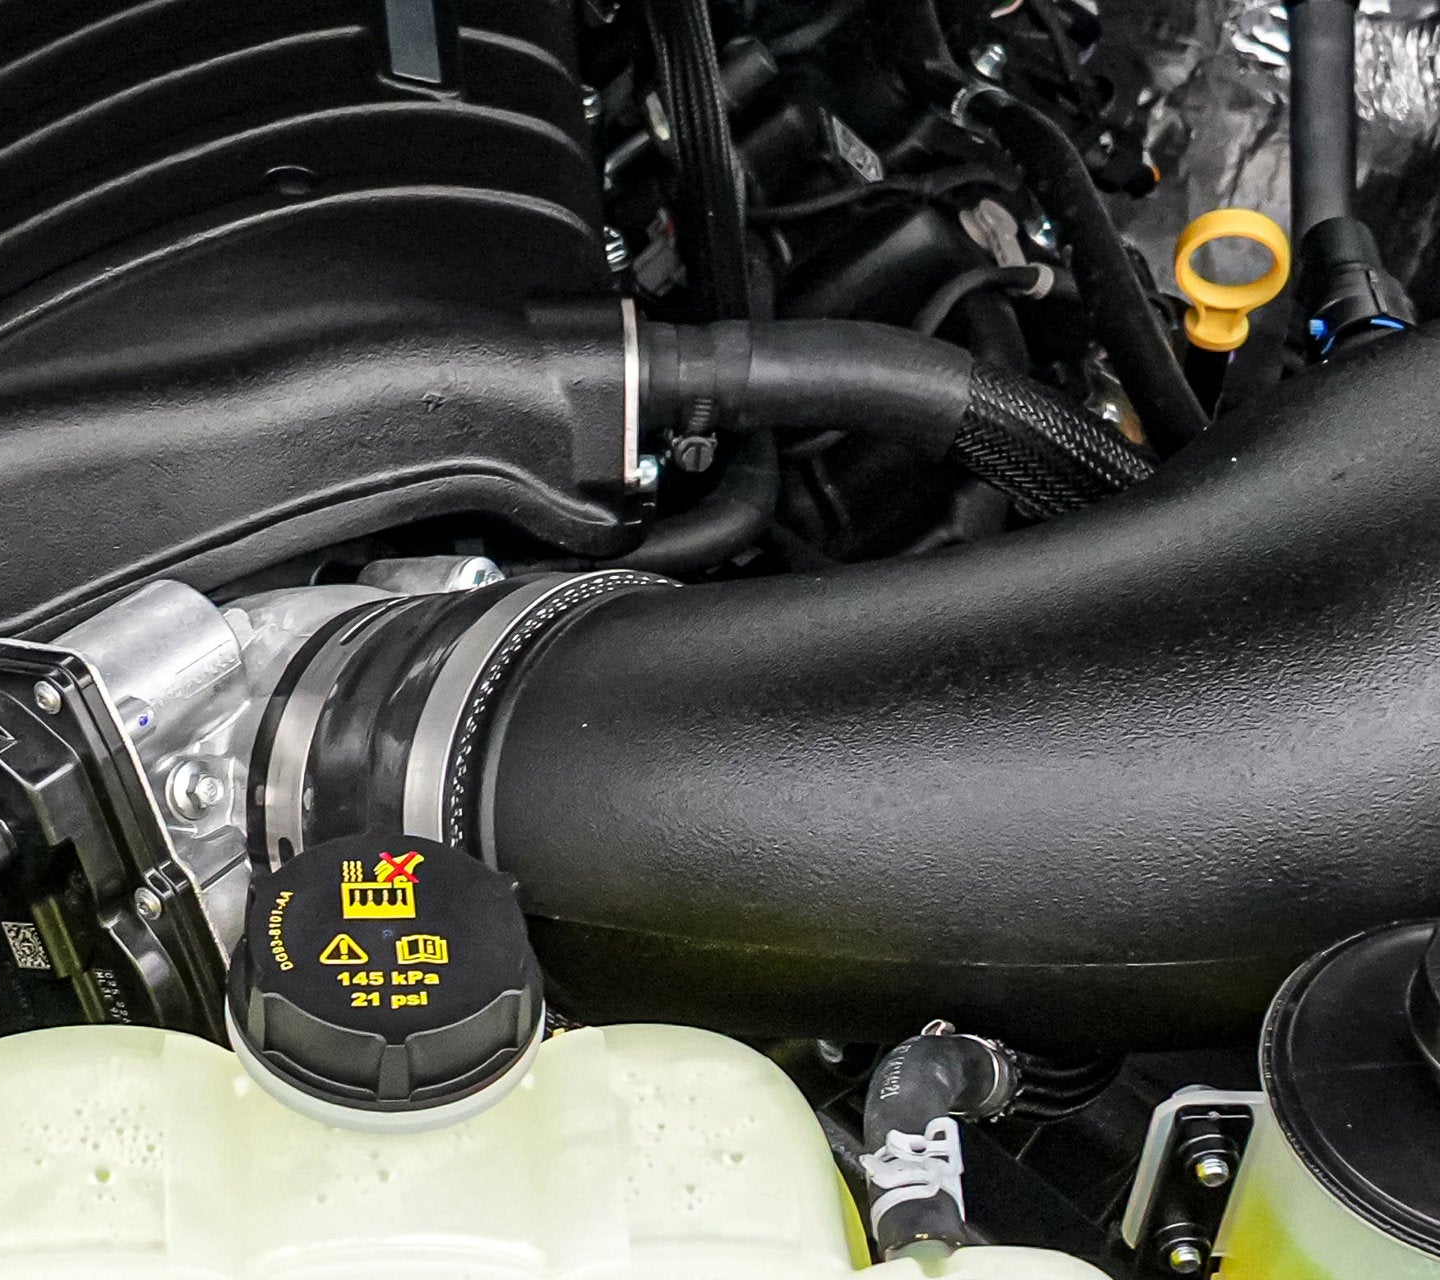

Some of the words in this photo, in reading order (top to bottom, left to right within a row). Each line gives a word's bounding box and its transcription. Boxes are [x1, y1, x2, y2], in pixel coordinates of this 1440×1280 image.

[337, 972, 384, 986] 145
[391, 971, 440, 986] kPa
[351, 992, 380, 1007] 21
[391, 991, 428, 1009] psi
